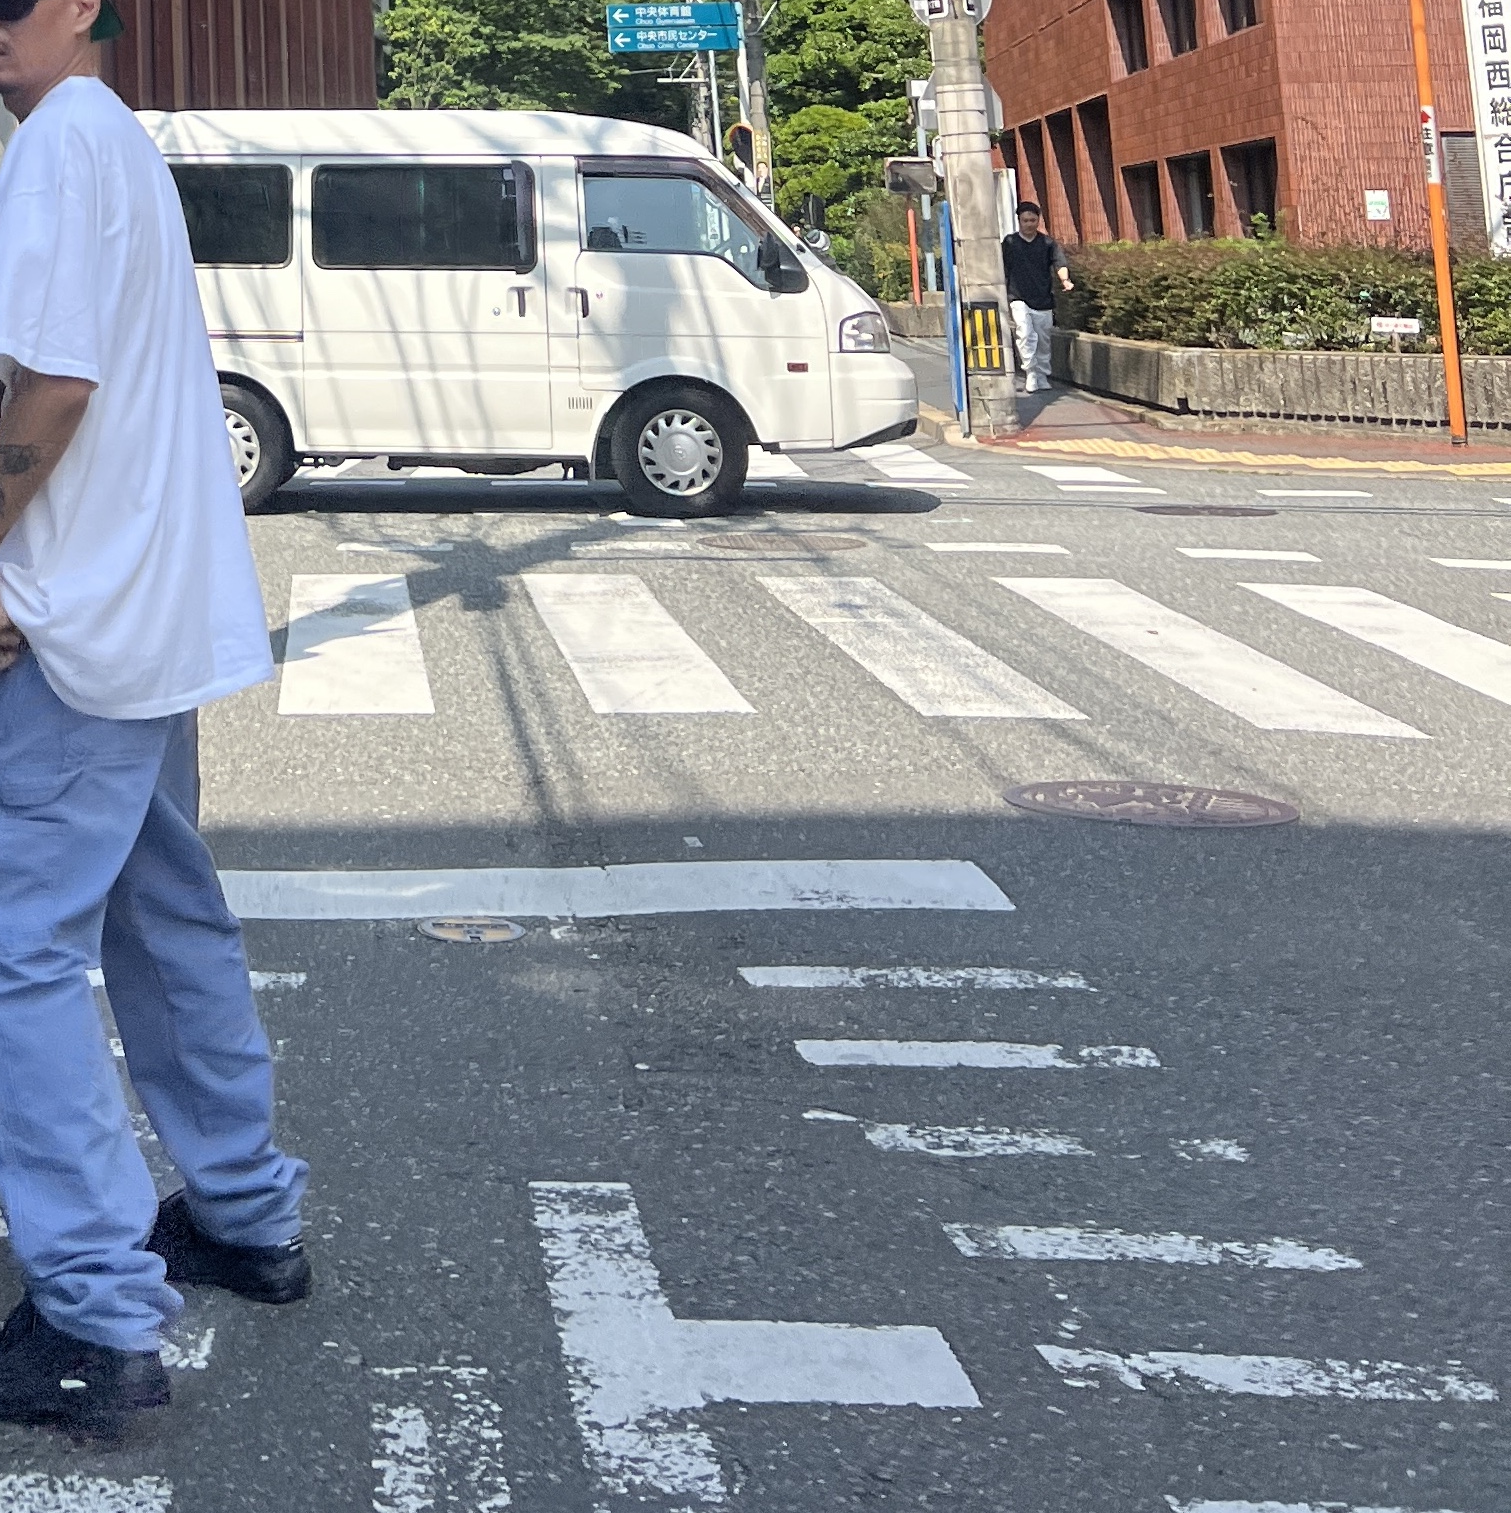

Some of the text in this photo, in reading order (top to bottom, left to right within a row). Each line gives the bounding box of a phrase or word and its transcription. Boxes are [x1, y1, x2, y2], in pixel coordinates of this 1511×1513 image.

[635, 6, 692, 17] 中央体育館
[636, 29, 718, 41] 中央市民センター
